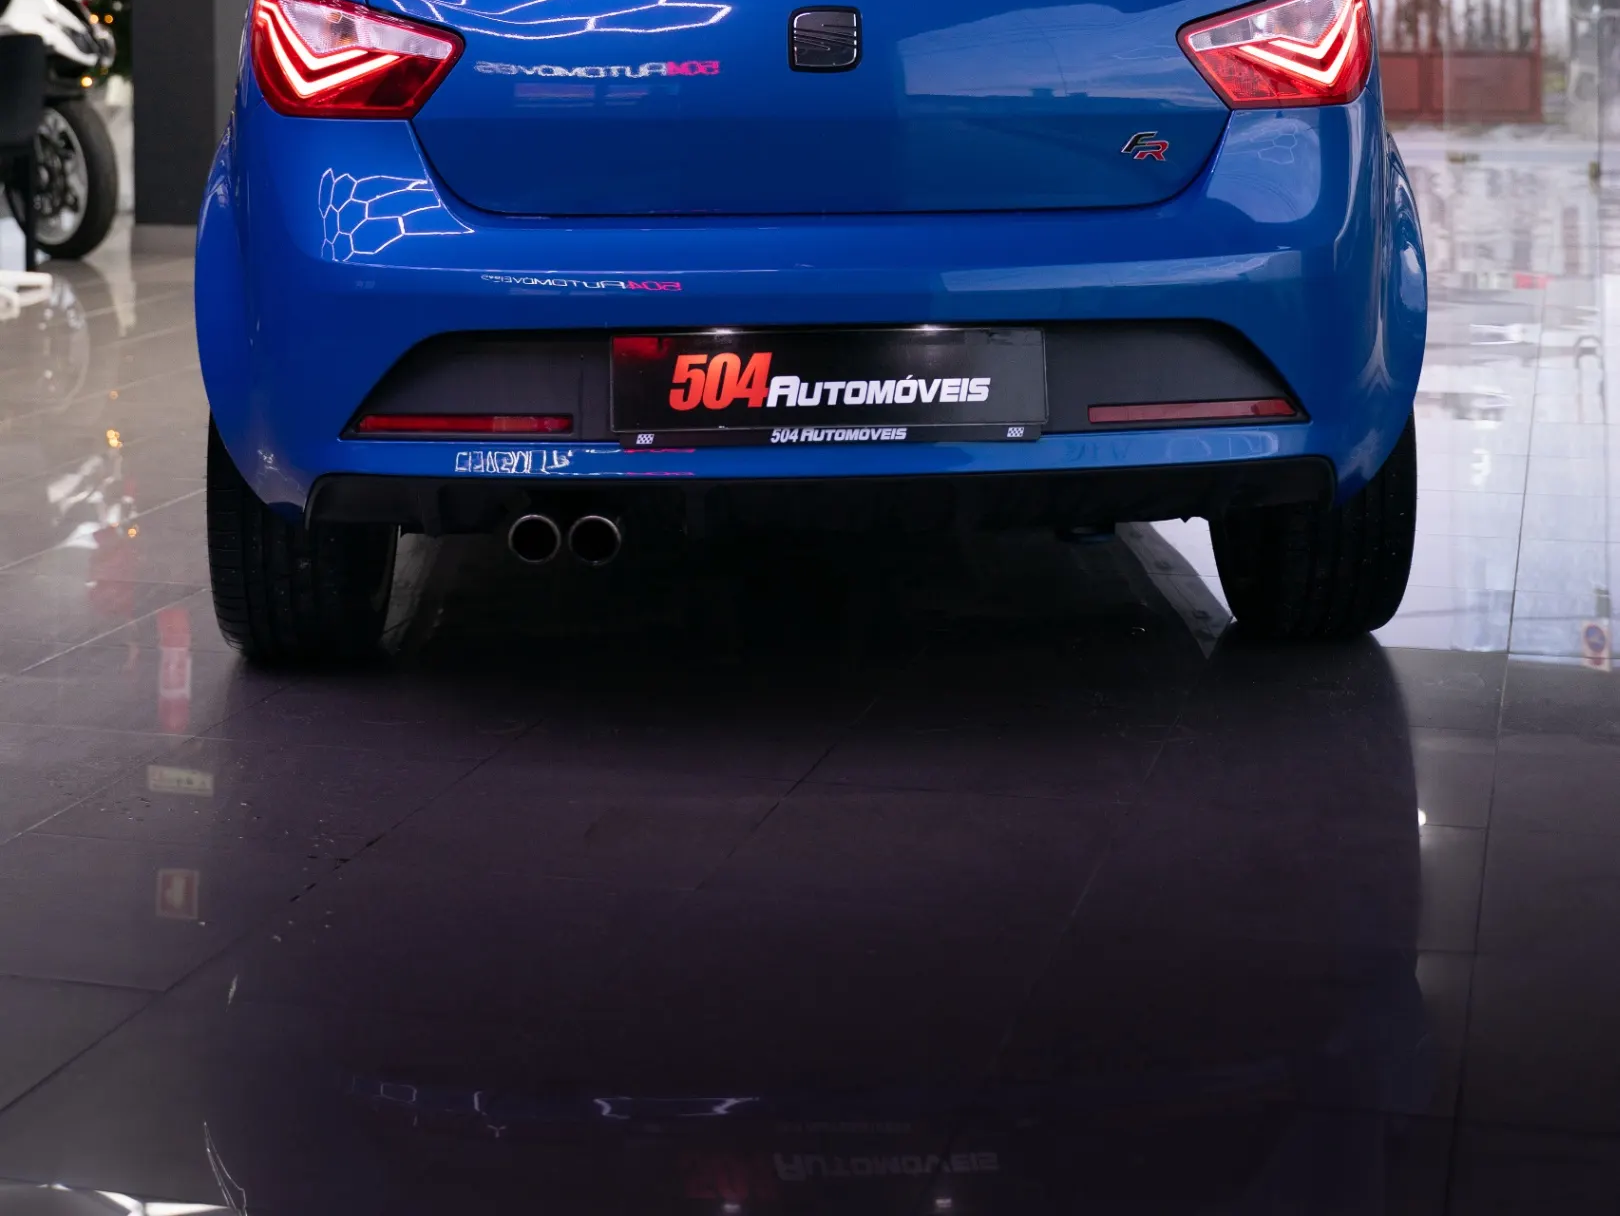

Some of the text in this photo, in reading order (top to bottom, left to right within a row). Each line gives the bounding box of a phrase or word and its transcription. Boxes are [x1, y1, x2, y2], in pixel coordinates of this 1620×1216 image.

[1121, 131, 1169, 161] FR
[669, 352, 773, 411] 504
[771, 429, 798, 443] 504
